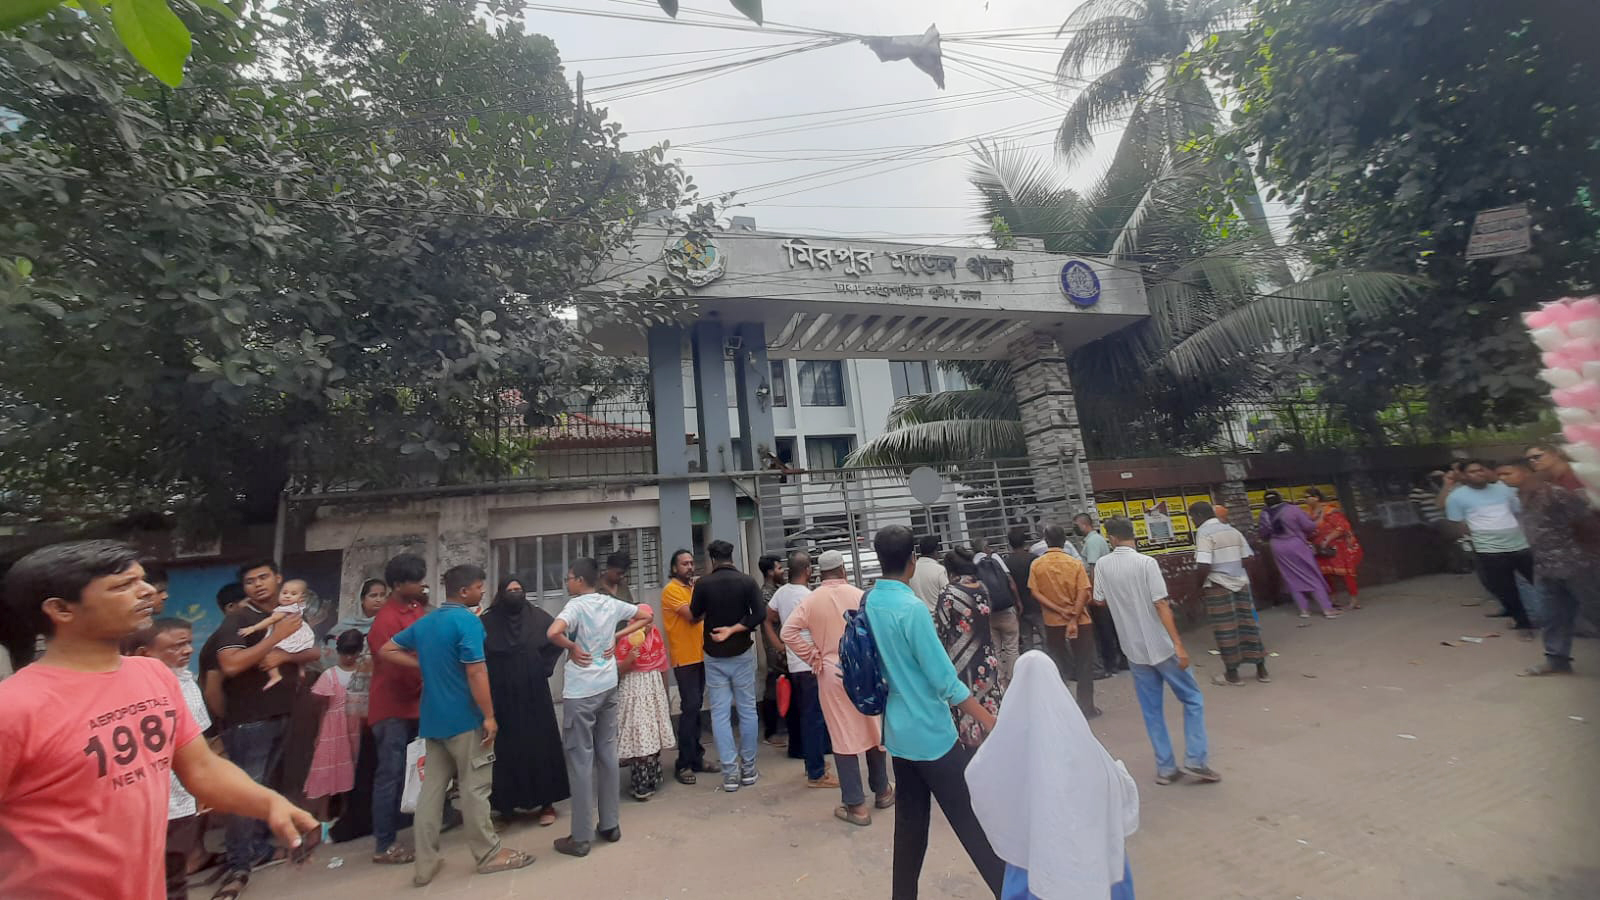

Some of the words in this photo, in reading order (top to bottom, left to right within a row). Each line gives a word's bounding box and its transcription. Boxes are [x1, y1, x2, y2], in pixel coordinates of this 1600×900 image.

[782, 238, 874, 278] মিরপুর
[883, 250, 958, 279] মডেল
[966, 254, 1015, 282] থানা
[83, 709, 177, 779] 1987
[112, 766, 146, 791] NEW
[150, 756, 170, 773] YOR
